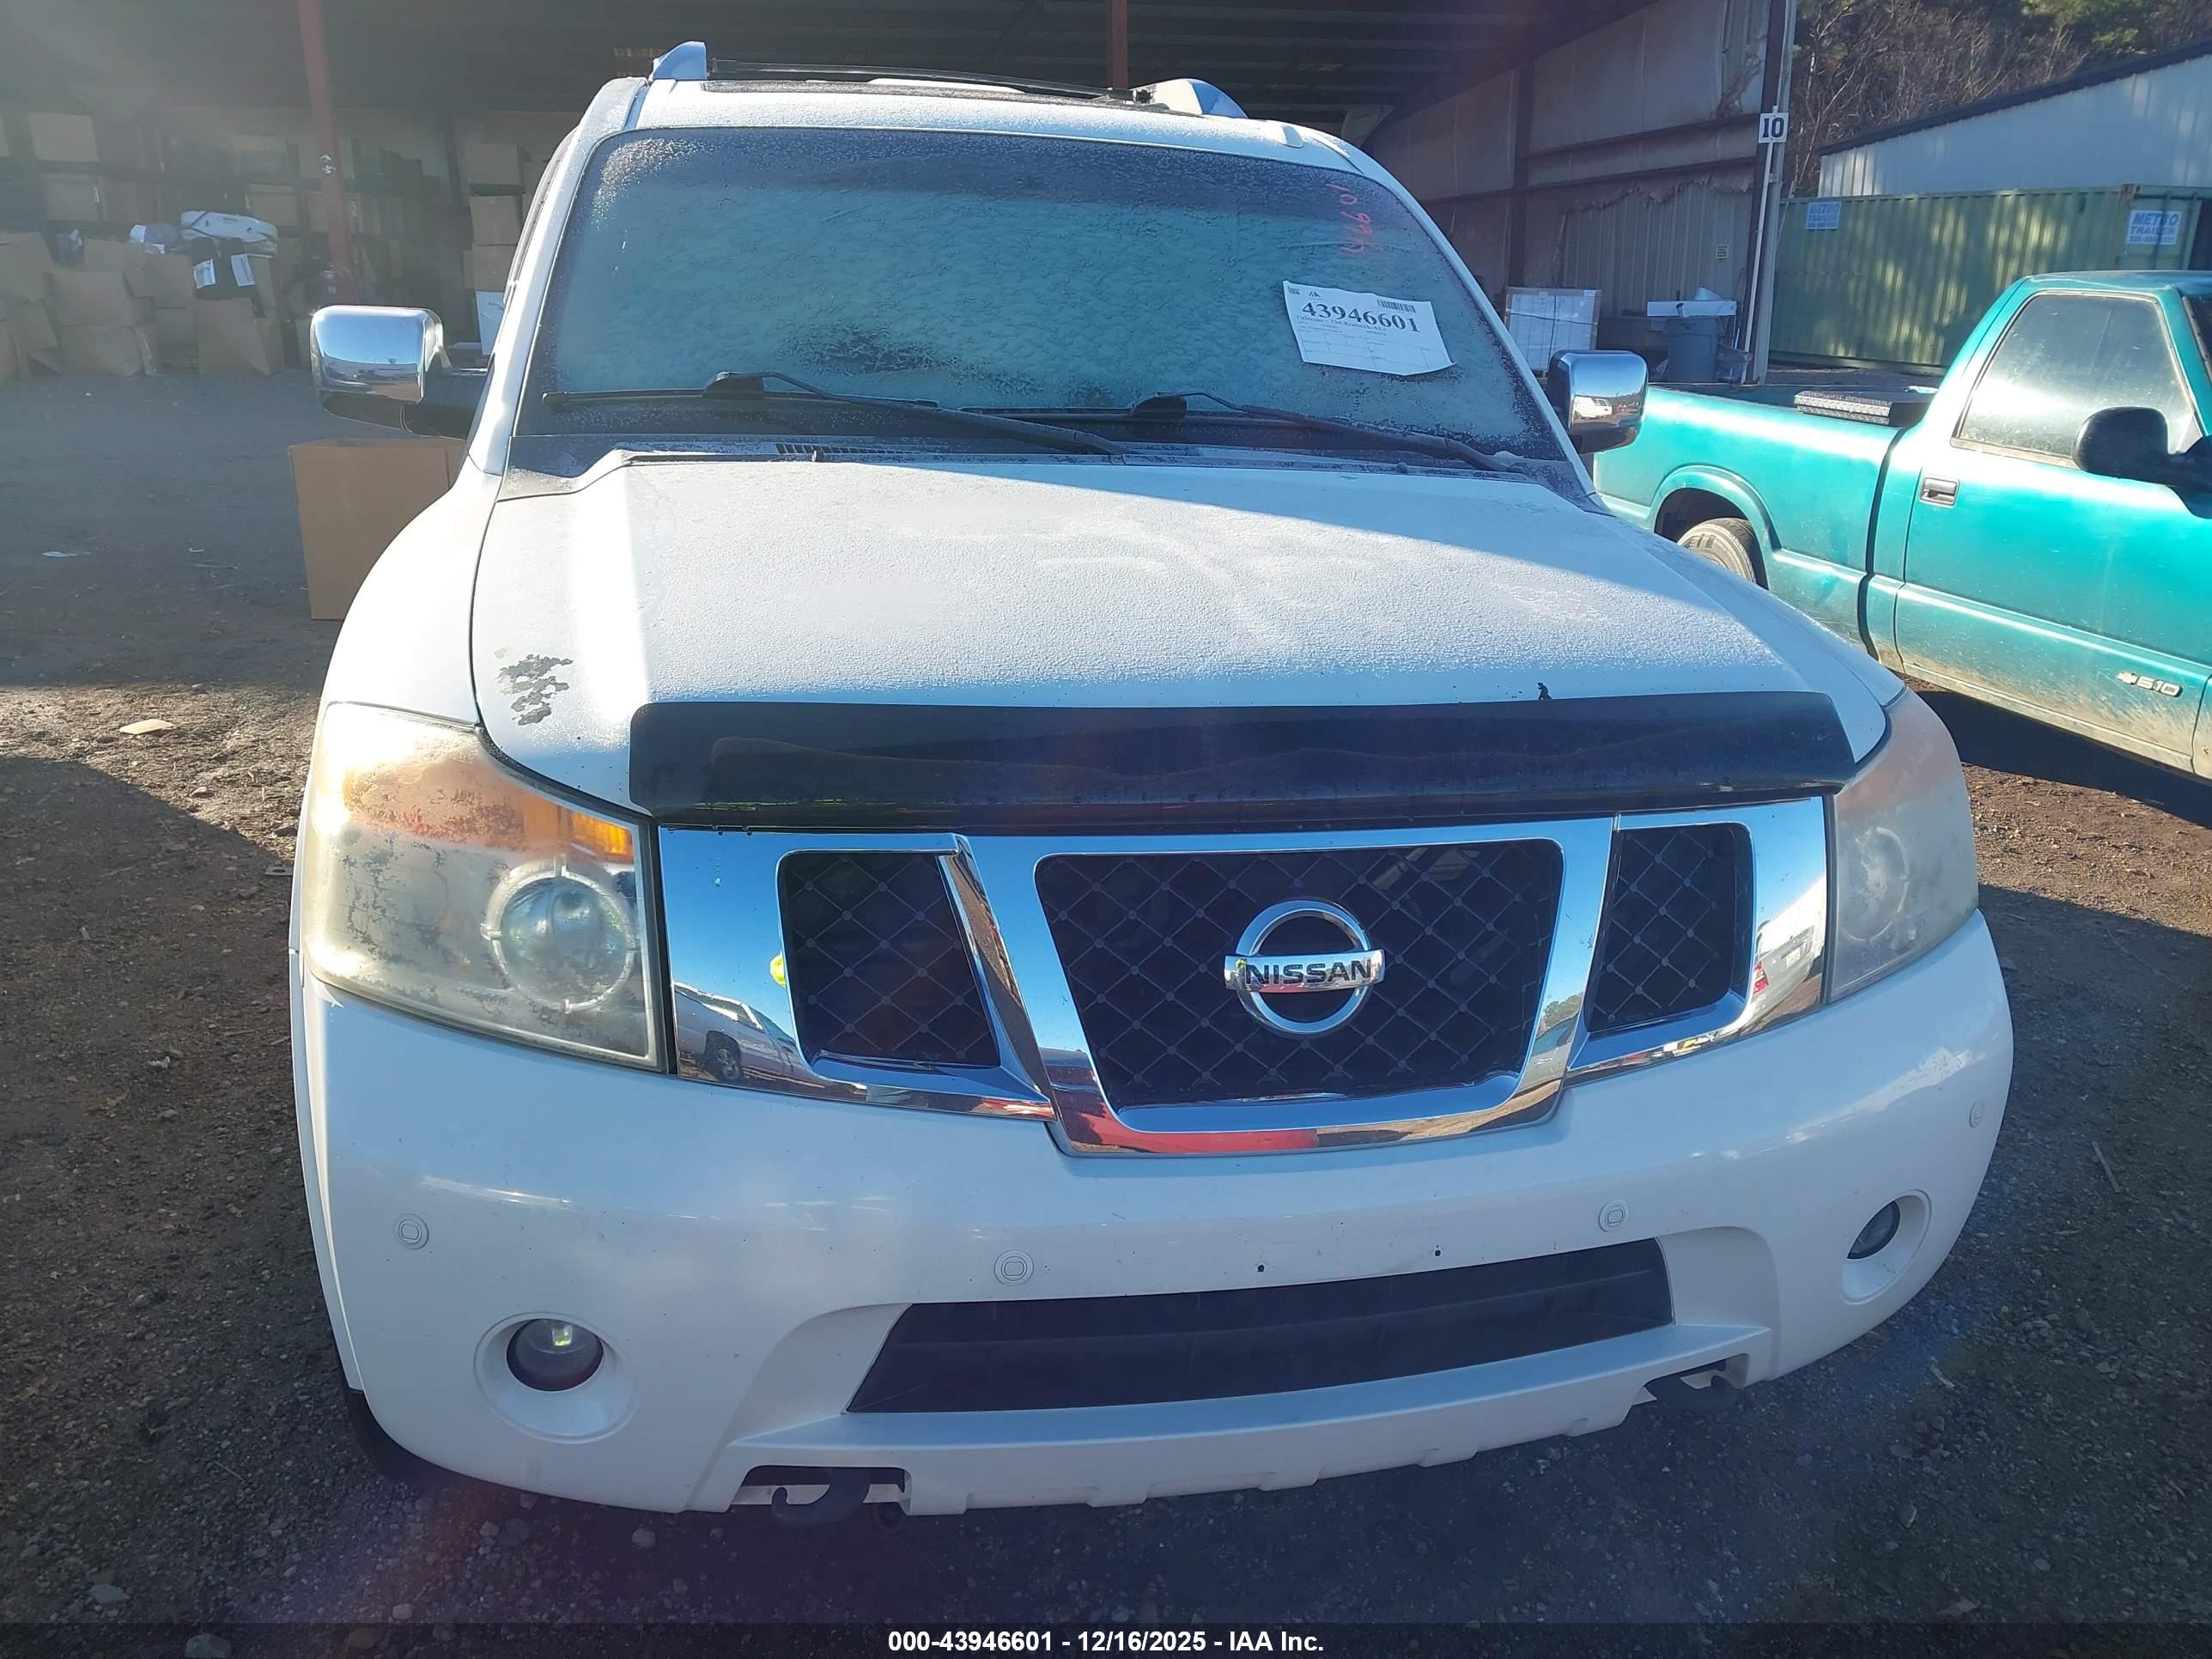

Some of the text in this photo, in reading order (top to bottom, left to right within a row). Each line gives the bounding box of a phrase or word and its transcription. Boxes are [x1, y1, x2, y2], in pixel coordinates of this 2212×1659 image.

[1763, 117, 1784, 138] 10
[1302, 302, 1421, 332] 43946601
[1246, 958, 1371, 985] NISSAN
